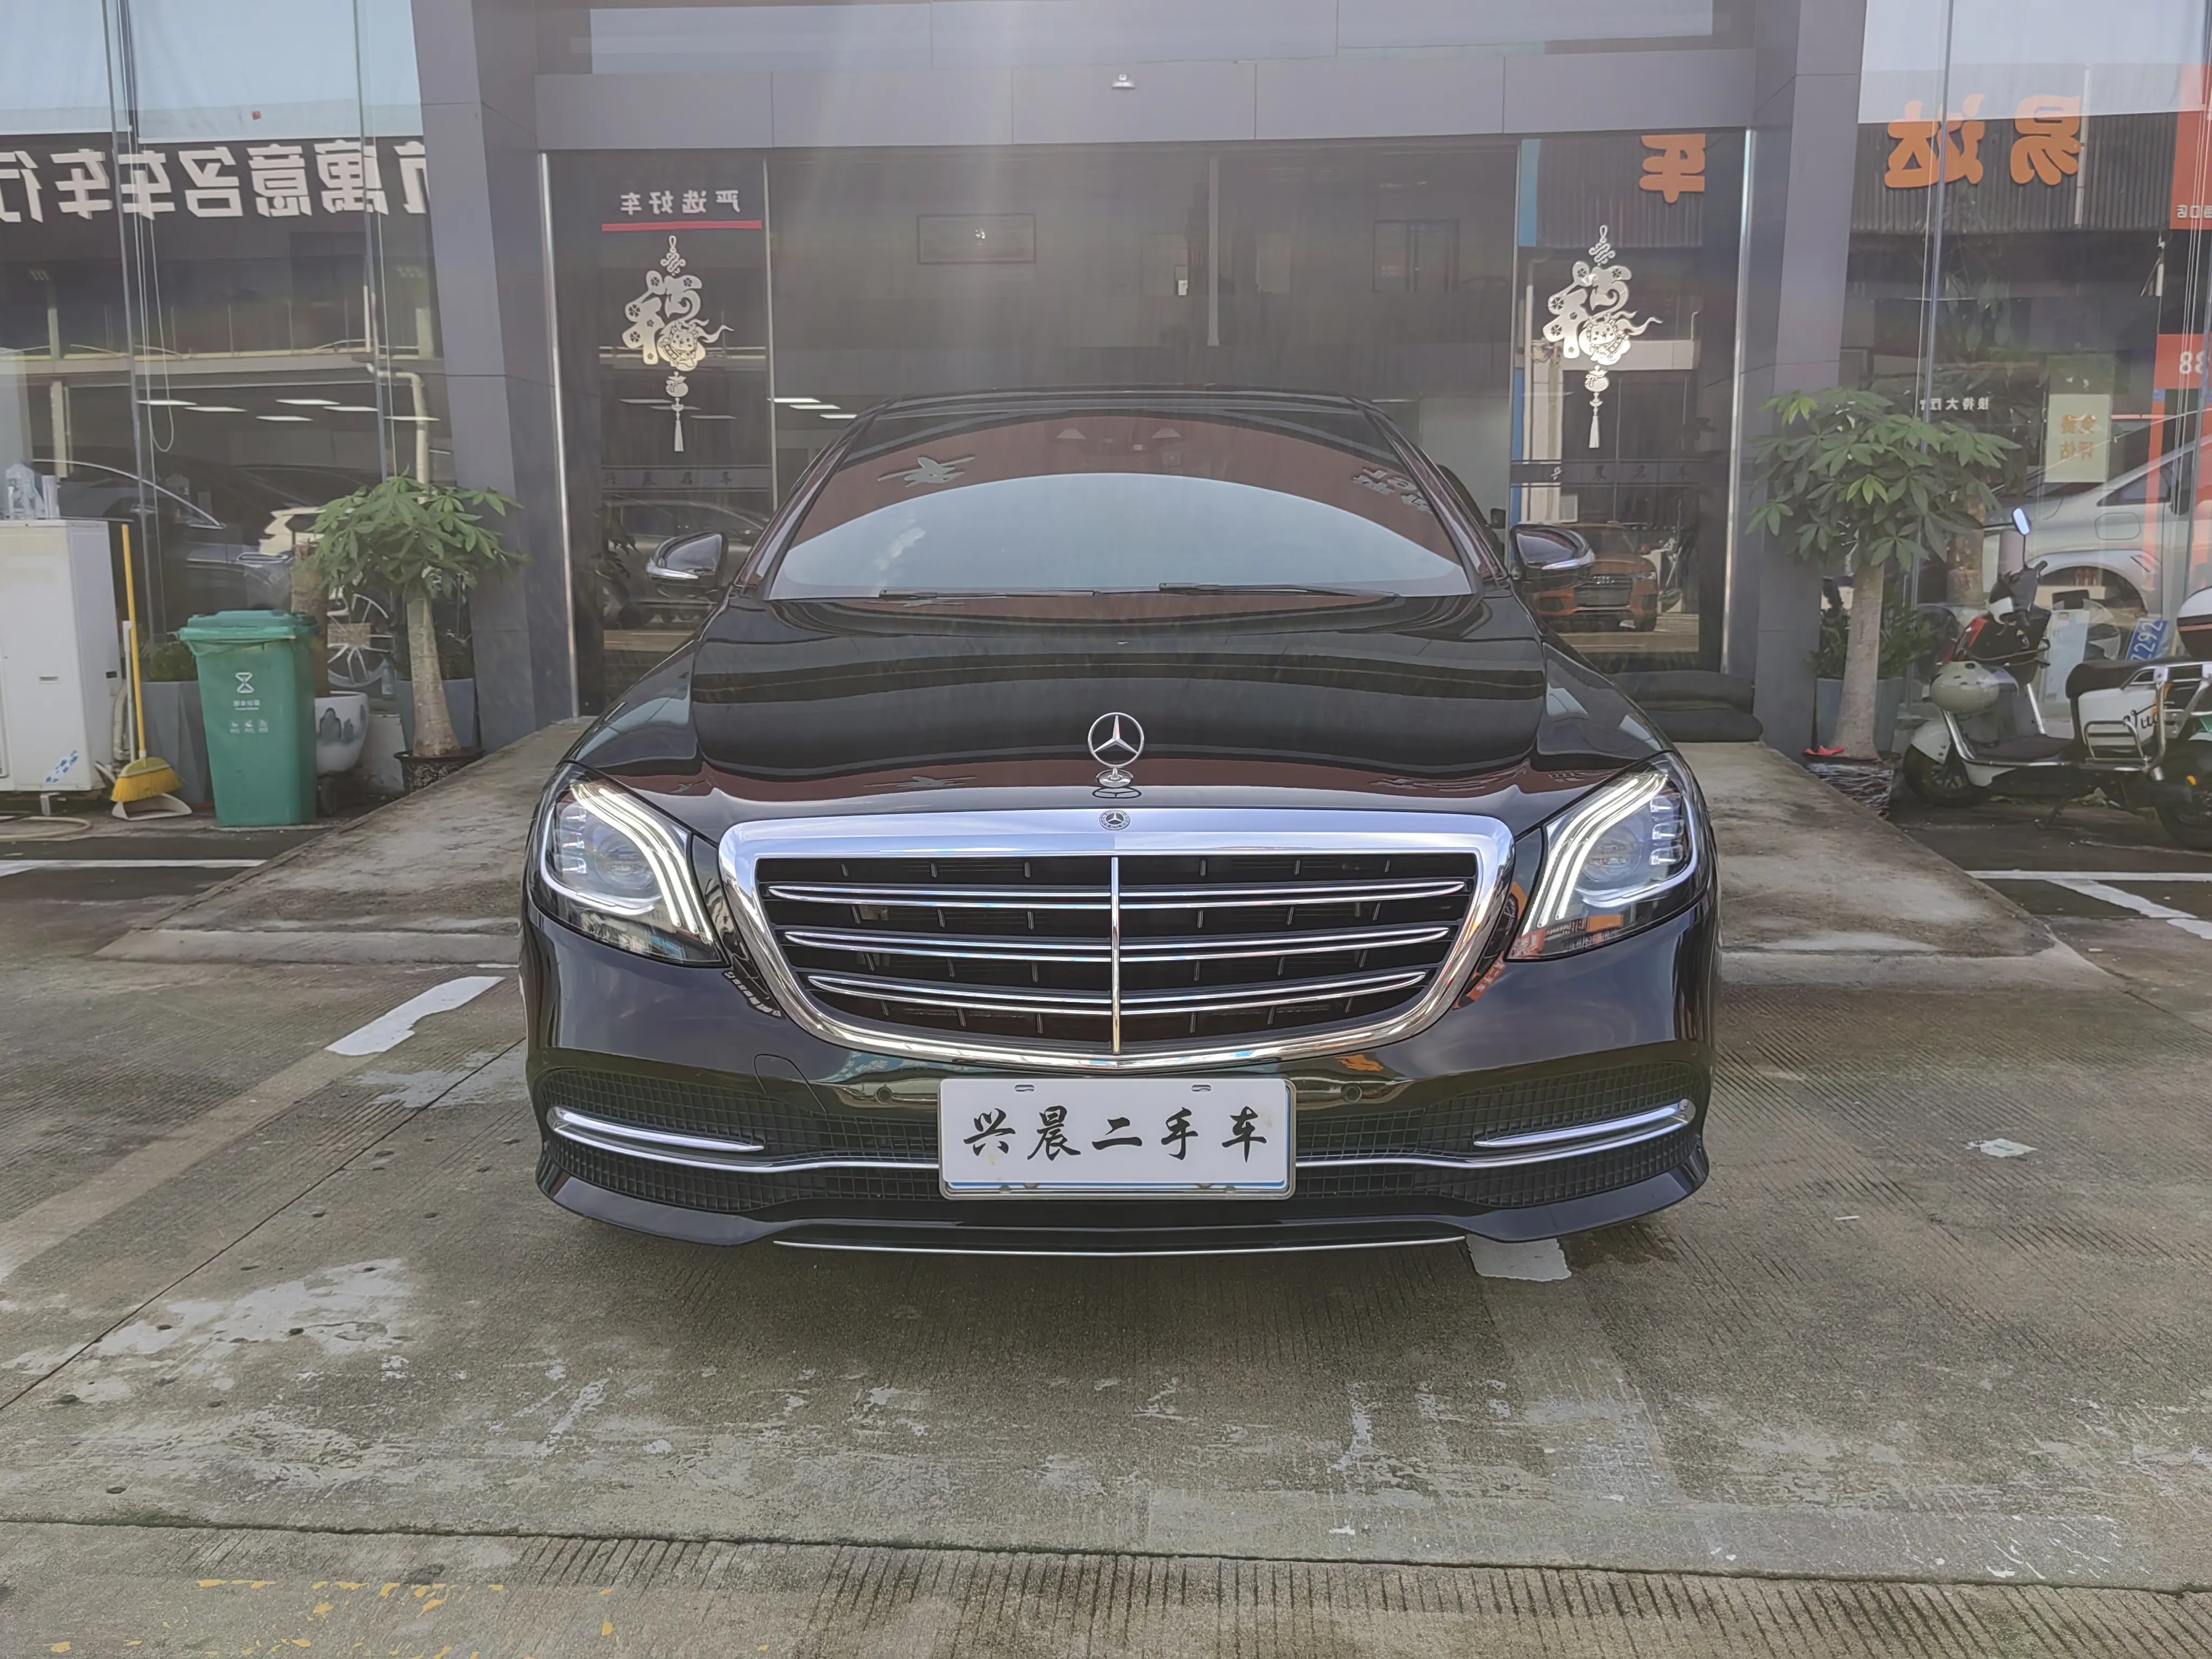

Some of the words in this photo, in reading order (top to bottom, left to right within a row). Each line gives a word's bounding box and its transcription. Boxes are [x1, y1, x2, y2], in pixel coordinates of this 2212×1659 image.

[963, 1105, 1267, 1163] 兴晨二手车
